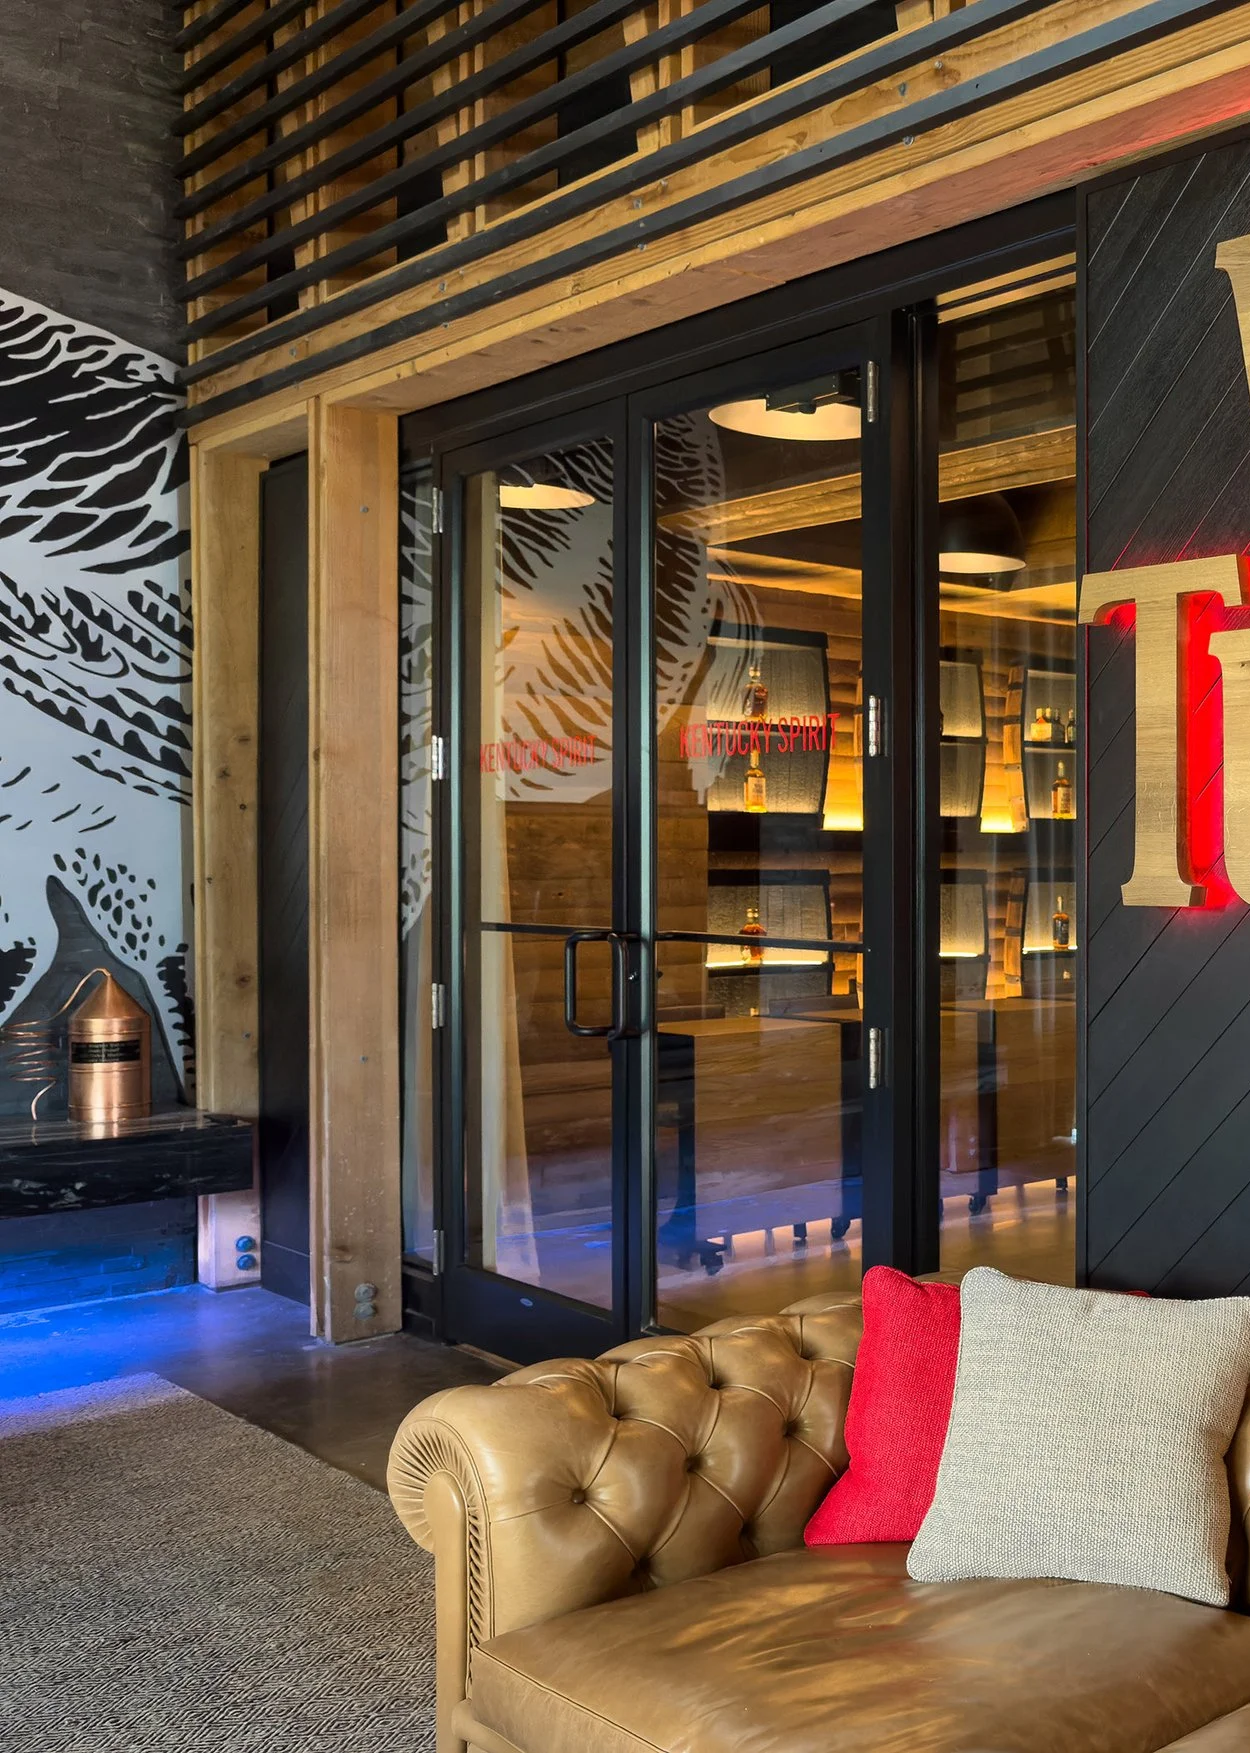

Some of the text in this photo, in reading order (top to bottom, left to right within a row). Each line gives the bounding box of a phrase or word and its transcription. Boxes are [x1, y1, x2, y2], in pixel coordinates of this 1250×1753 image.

[480, 735, 597, 773] KENTUCKY SPIRIT
[680, 712, 841, 758] KENTUCKY SPIRIT
